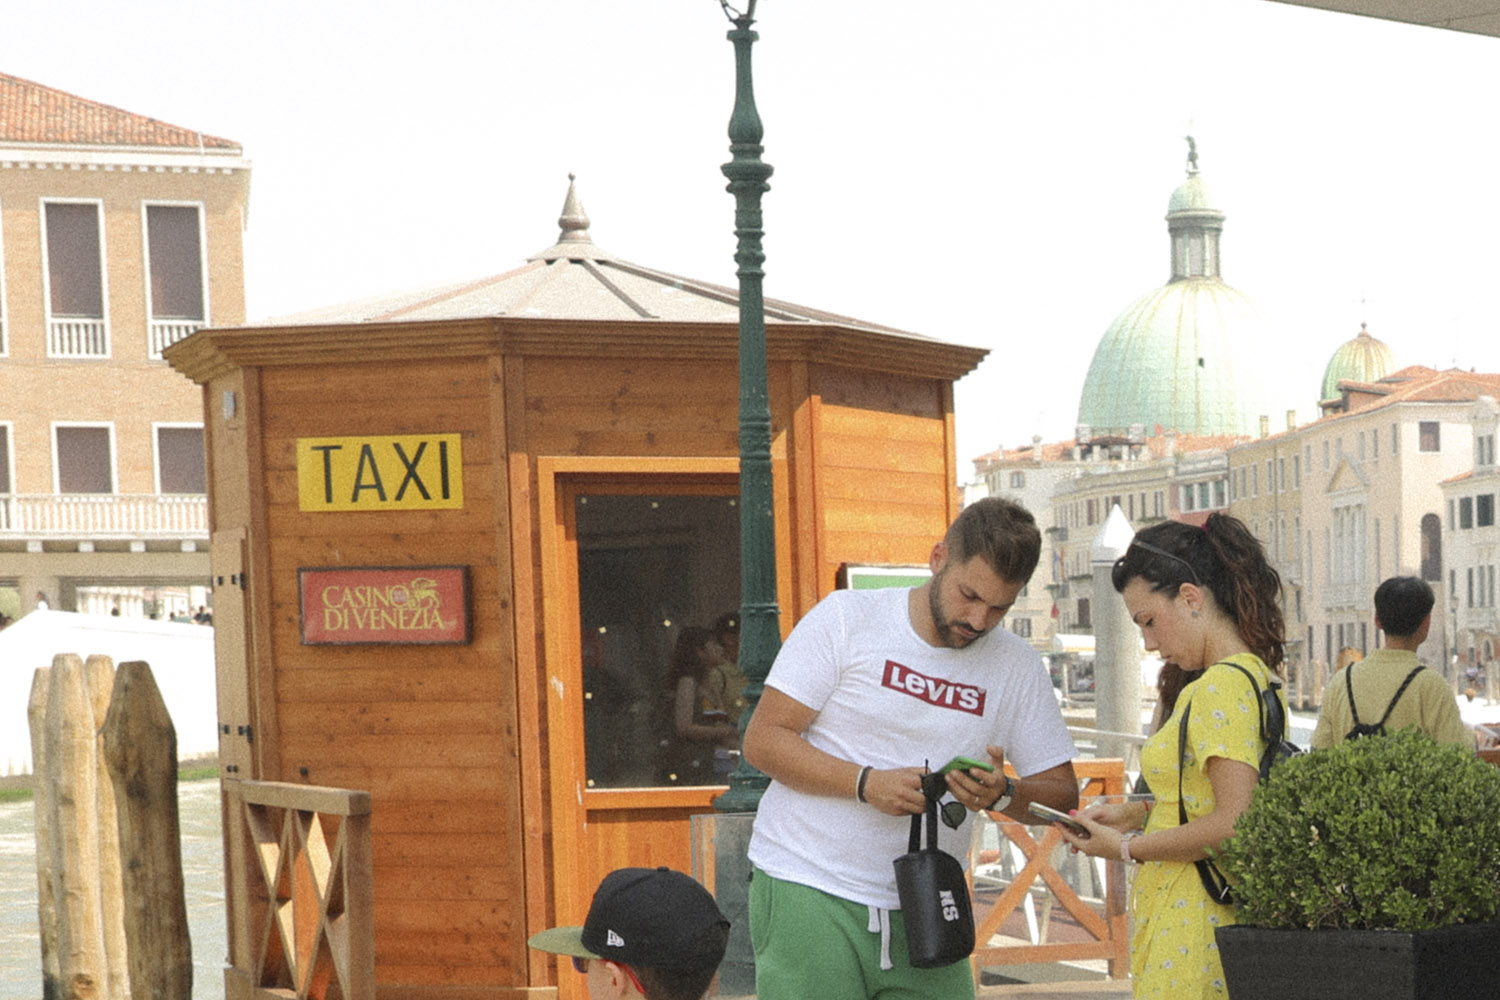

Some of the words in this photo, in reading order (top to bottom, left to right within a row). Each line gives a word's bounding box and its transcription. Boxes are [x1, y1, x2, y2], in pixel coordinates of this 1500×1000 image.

[310, 440, 450, 504] TAXI
[322, 584, 411, 609] CASINO
[324, 608, 349, 631] DI
[351, 608, 446, 631] VENEZIA
